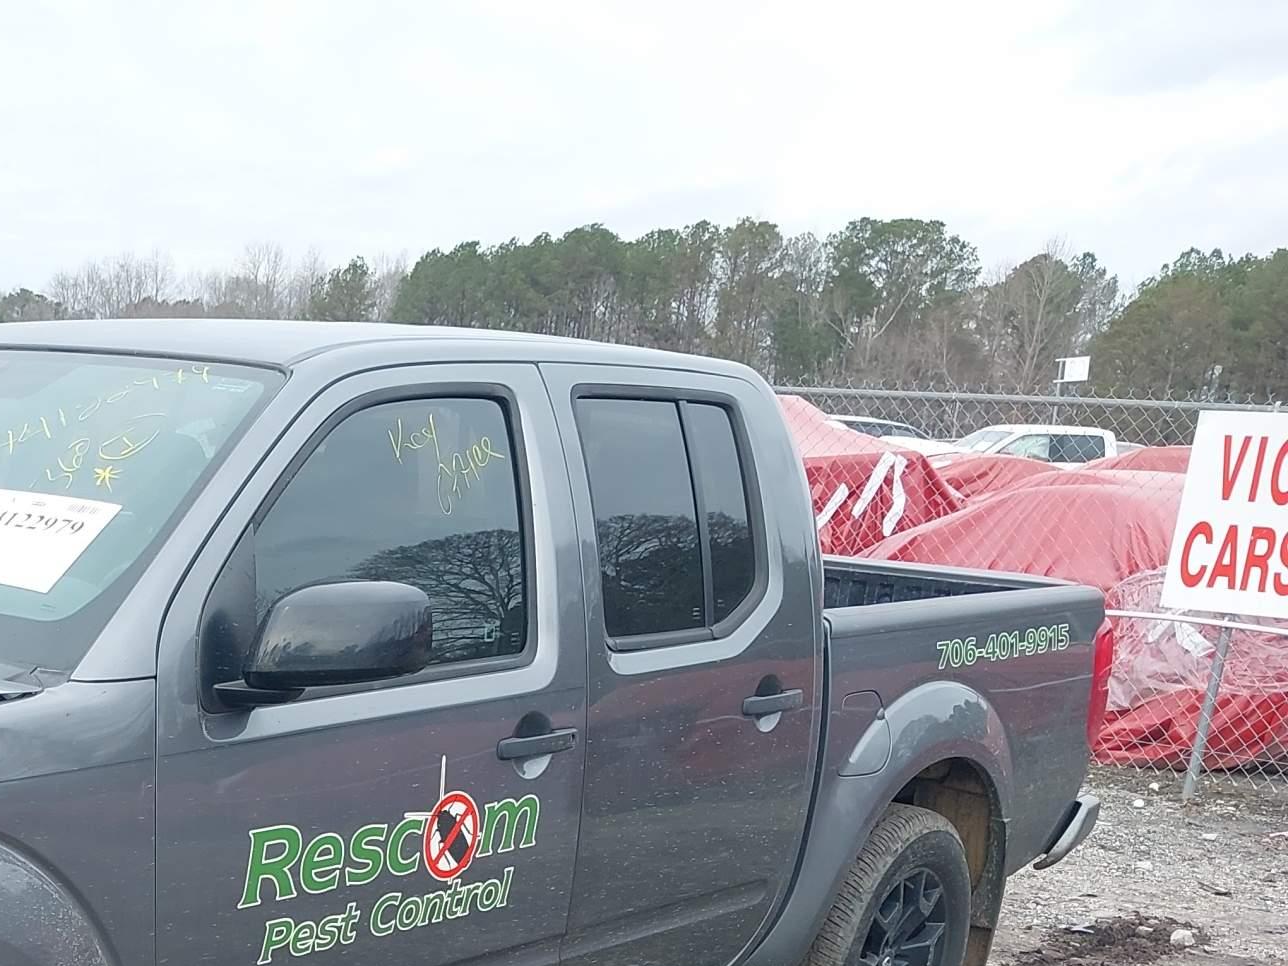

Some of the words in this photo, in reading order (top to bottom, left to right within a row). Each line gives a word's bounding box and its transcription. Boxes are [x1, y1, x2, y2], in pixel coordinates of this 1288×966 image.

[935, 622, 1070, 670] 706-401-9915
[257, 902, 361, 965] Pest
[369, 866, 514, 938] Control
